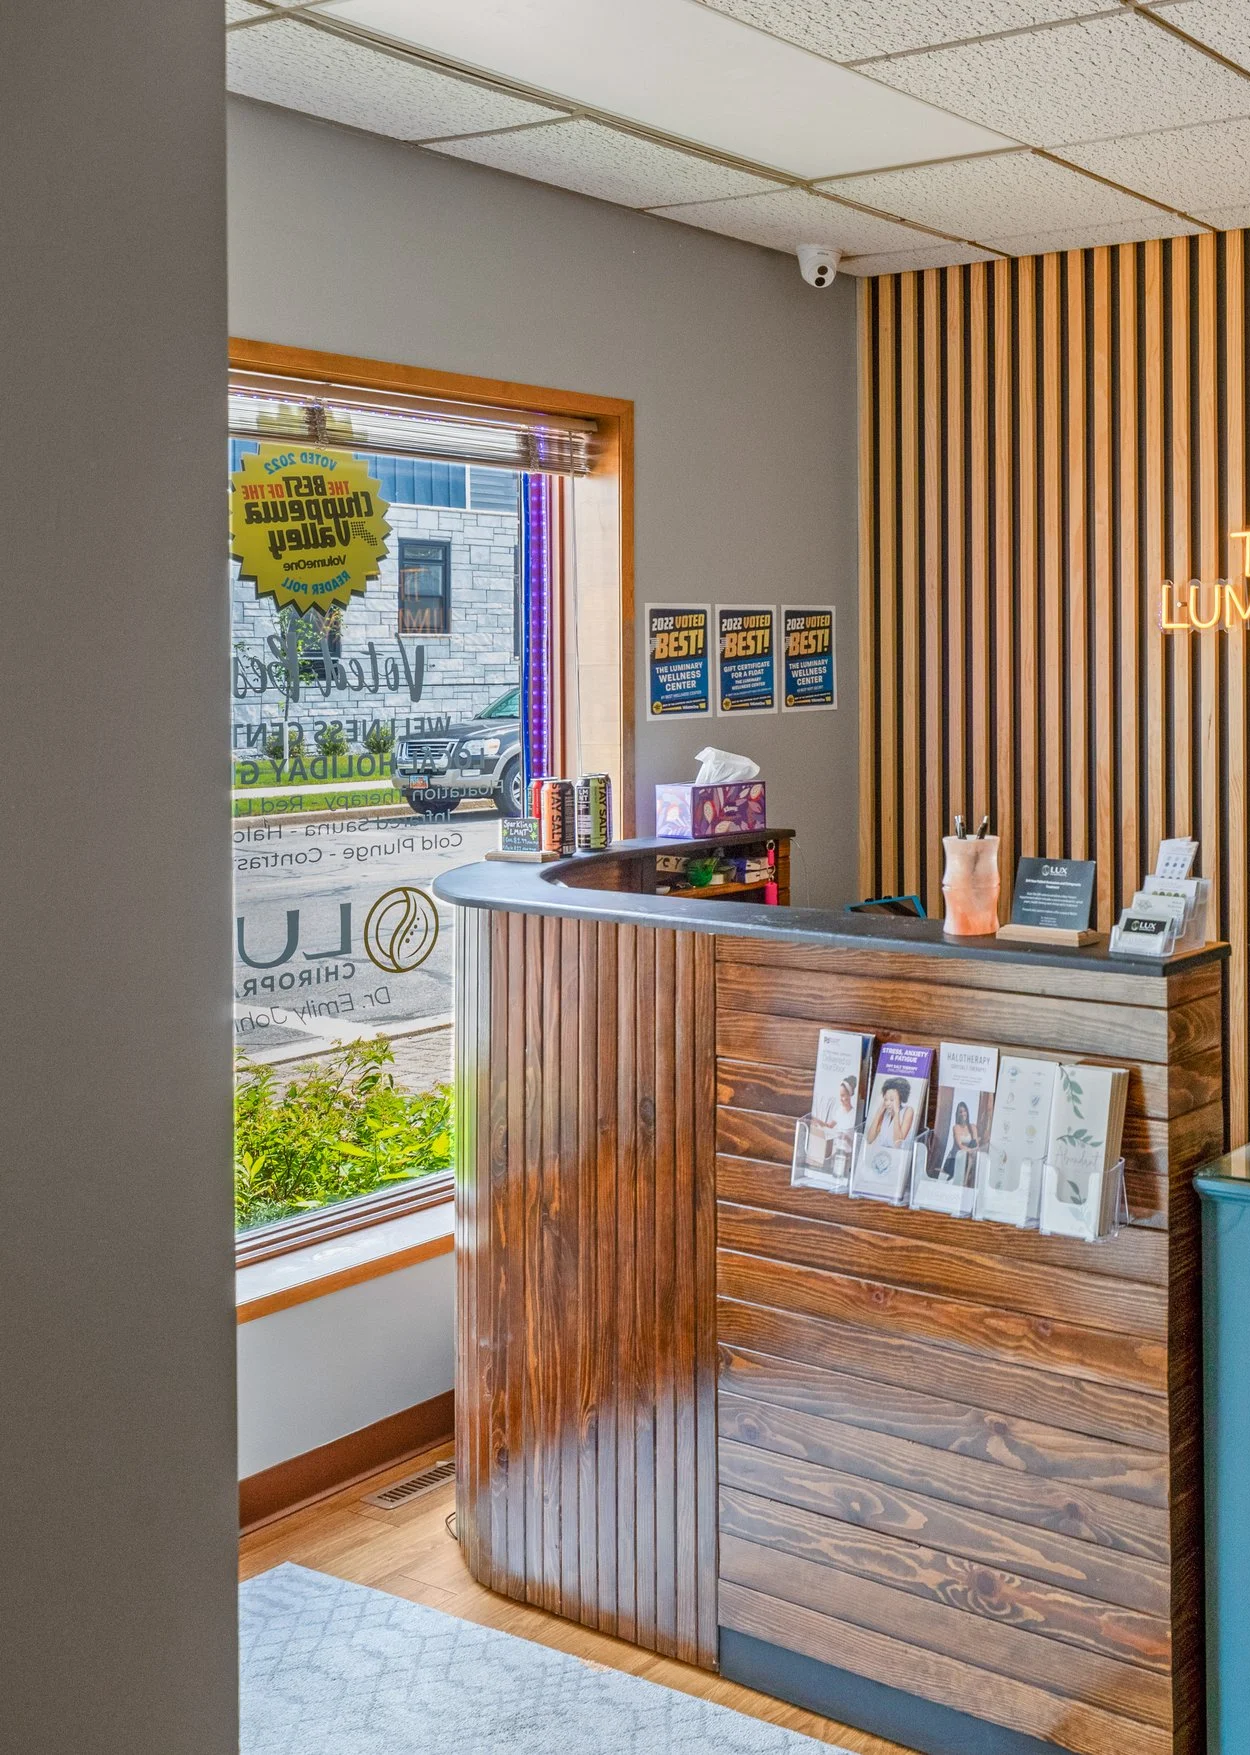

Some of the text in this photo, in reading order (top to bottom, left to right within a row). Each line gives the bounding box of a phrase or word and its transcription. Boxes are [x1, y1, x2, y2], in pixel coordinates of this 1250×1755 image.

[652, 614, 705, 631] 2022 VOTED
[721, 615, 771, 631] 2022 VOTED
[786, 615, 831, 631] 2022 VOTED
[655, 628, 704, 659] BEST!
[724, 629, 770, 658] BEST!
[788, 629, 829, 656] BEST!
[656, 662, 703, 674] THE LUMINARY
[723, 661, 771, 673] GIFT CERTIFICATE
[789, 658, 829, 670] THE LUMINARY
[659, 670, 701, 683] WELLNESS
[791, 666, 827, 678] WELLNESS
[665, 680, 696, 691] CENTER
[796, 675, 823, 686] CENTER
[552, 783, 563, 853] STAY SALTY
[598, 779, 608, 848] STAY SALTY
[503, 819, 533, 832] Sparkling
[1050, 866, 1068, 875] LUX
[1139, 921, 1157, 930] LUX
[882, 1047, 929, 1058] STRESS, ANXIETY
[895, 1055, 918, 1063] FATIGUE
[947, 1052, 991, 1065] HALOTHERAPY
